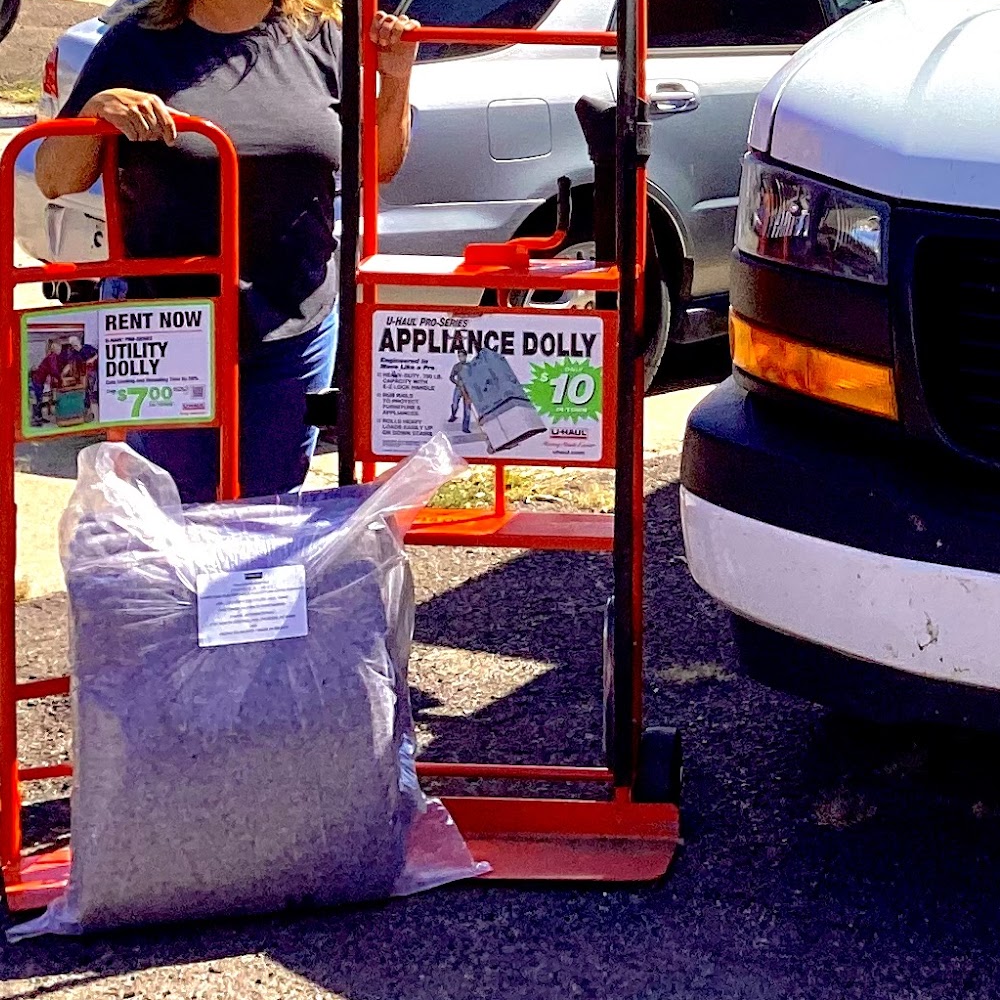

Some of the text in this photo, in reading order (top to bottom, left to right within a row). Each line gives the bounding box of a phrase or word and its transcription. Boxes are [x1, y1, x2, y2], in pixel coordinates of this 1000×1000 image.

[105, 310, 203, 331] RENT NOW
[386, 316, 468, 328] U-HAUL PRO-SERIES
[105, 341, 169, 360] UTILITY
[378, 327, 598, 358] APPLIANCE DOLLY
[105, 359, 161, 377] DOLLY
